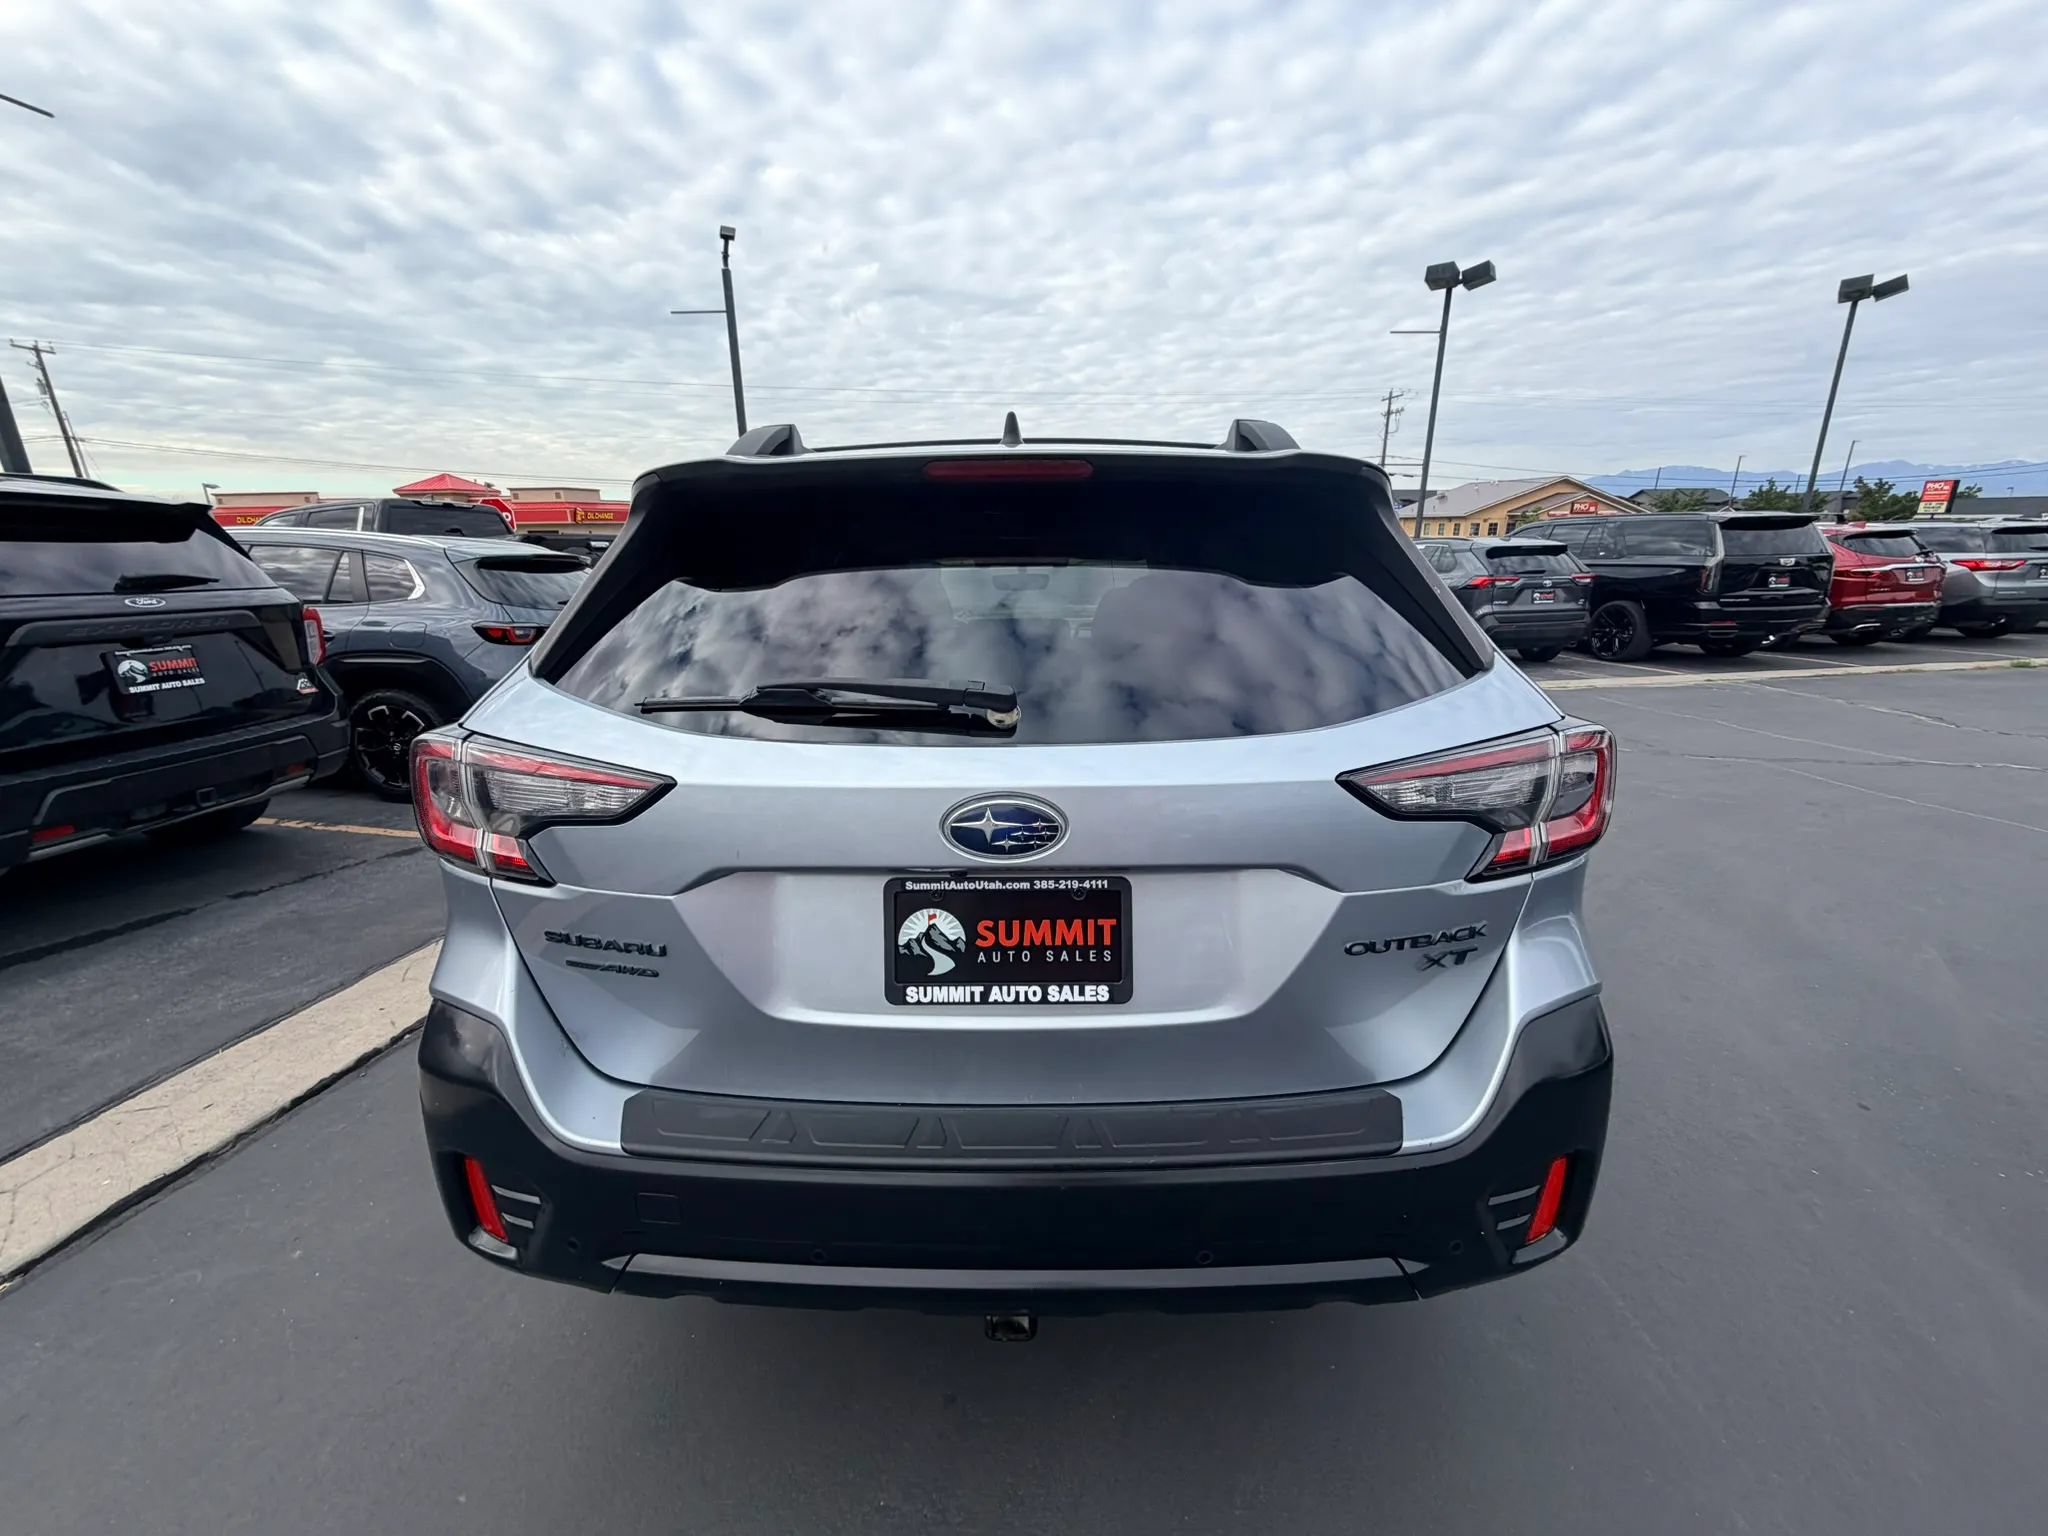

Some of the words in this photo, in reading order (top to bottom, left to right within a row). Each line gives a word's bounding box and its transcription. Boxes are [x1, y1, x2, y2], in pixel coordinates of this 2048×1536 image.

[149, 657, 198, 672] SUMMIT
[129, 683, 160, 693] SUMMIT
[161, 680, 182, 689] AUTO
[183, 677, 205, 686] SALES
[905, 881, 1030, 890] SummitAutoUtah.com
[1033, 880, 1108, 889] 385-219-4111
[975, 918, 1117, 947] SUMMIT
[1344, 923, 1488, 956] OUTBACK
[544, 930, 668, 957] SUBARU
[977, 950, 1031, 963] AUTO
[1046, 950, 1112, 962] SALES
[1420, 946, 1478, 971] XT
[905, 986, 984, 1003] SUMMIT
[988, 985, 1042, 1002] AUTO
[1047, 985, 1110, 1002] SALES
